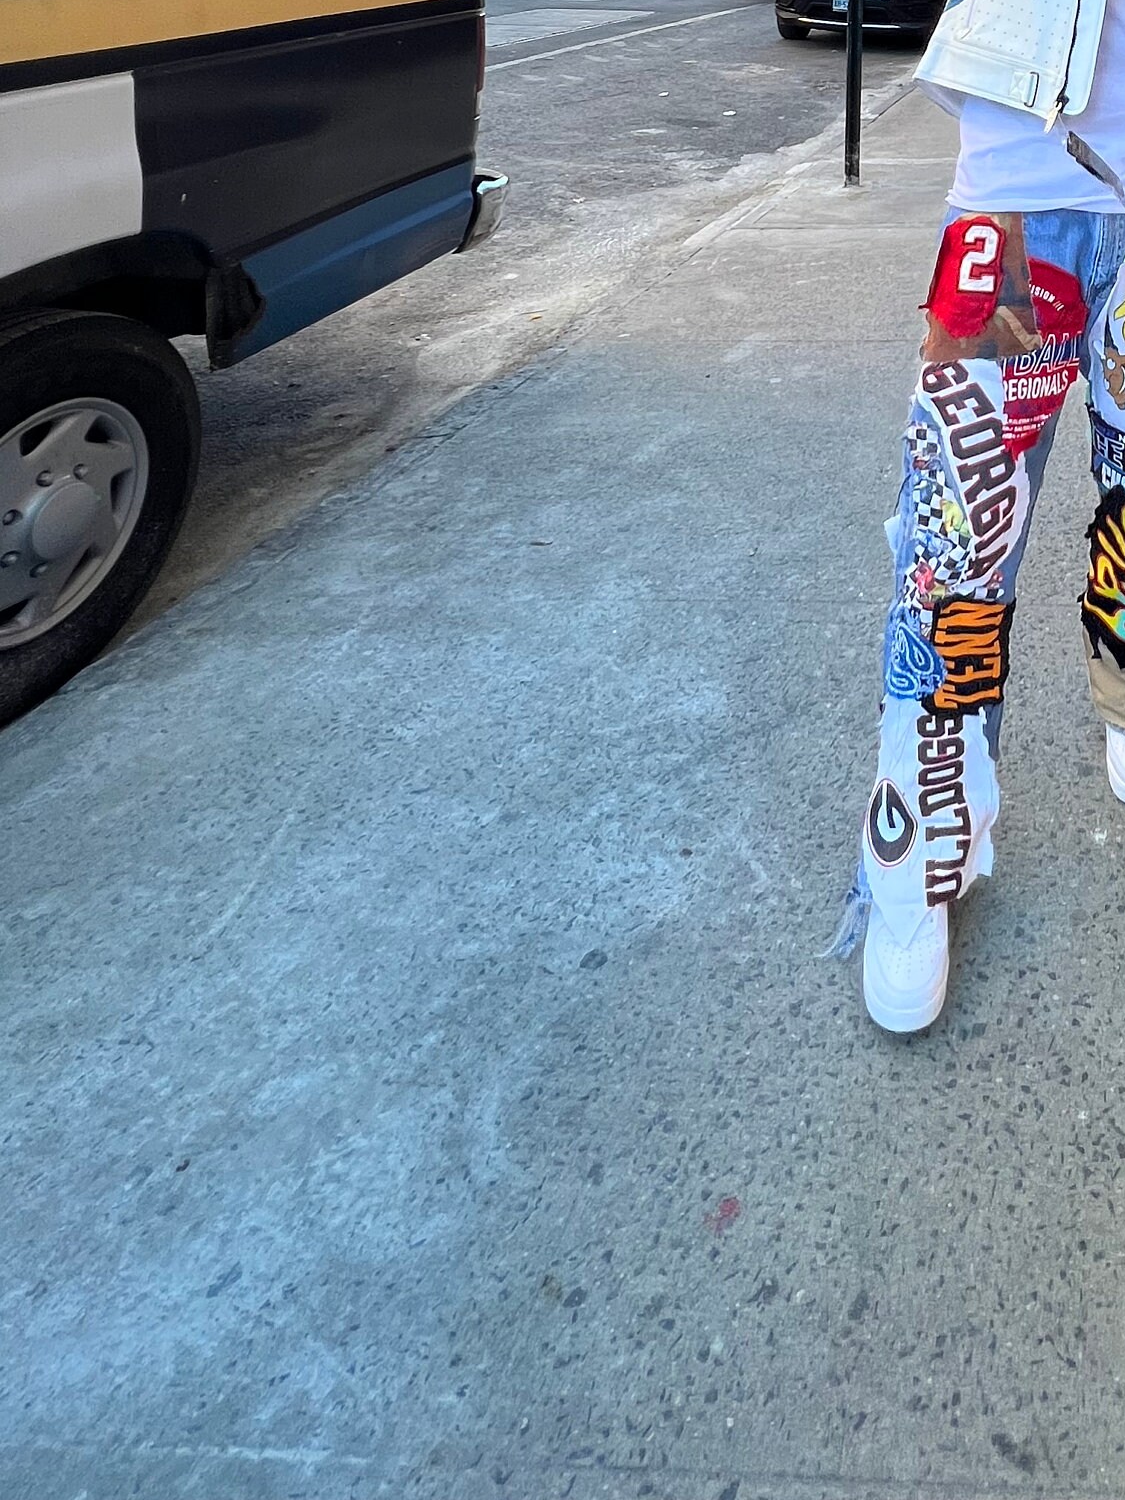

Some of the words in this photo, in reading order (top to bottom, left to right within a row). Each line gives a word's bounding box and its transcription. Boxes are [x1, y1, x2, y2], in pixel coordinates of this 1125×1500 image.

[957, 225, 999, 293] 2
[1029, 284, 1056, 303] ISION
[922, 360, 1016, 581] GEORGIA
[916, 711, 972, 907] ULLDOGS
